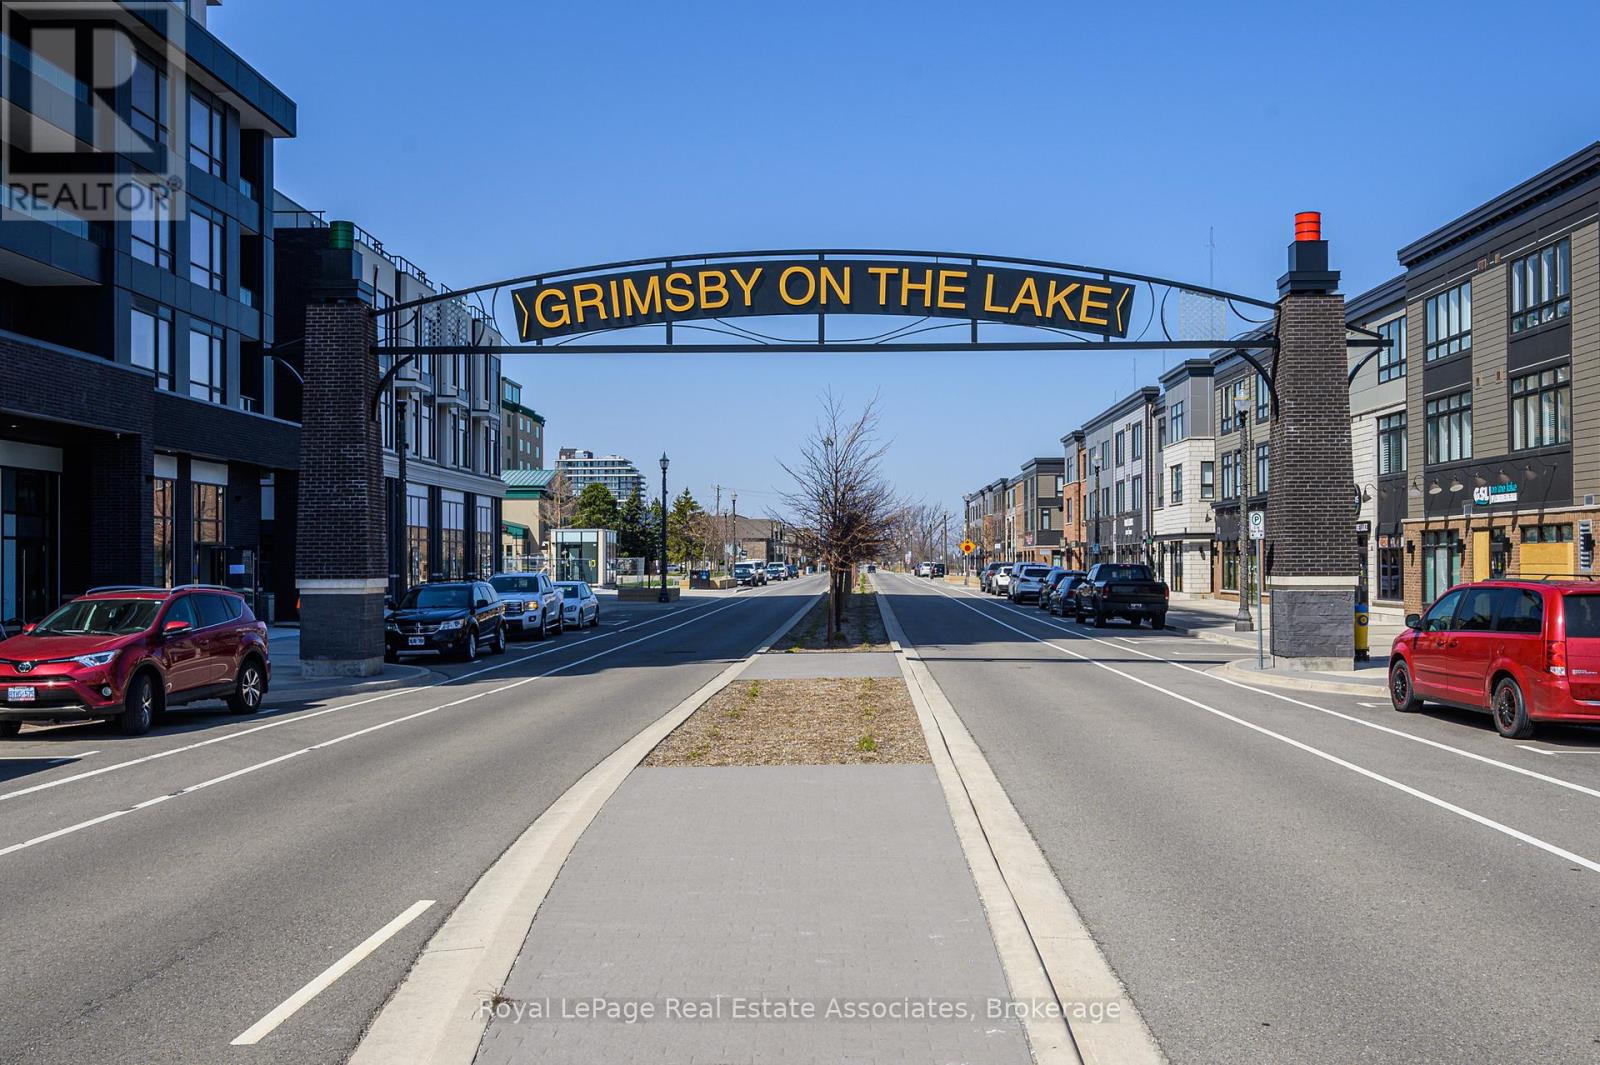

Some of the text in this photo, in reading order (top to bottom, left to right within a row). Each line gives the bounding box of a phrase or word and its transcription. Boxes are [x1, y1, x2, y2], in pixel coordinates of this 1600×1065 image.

[535, 266, 1112, 328] GRIMSBY ON THE LAKE
